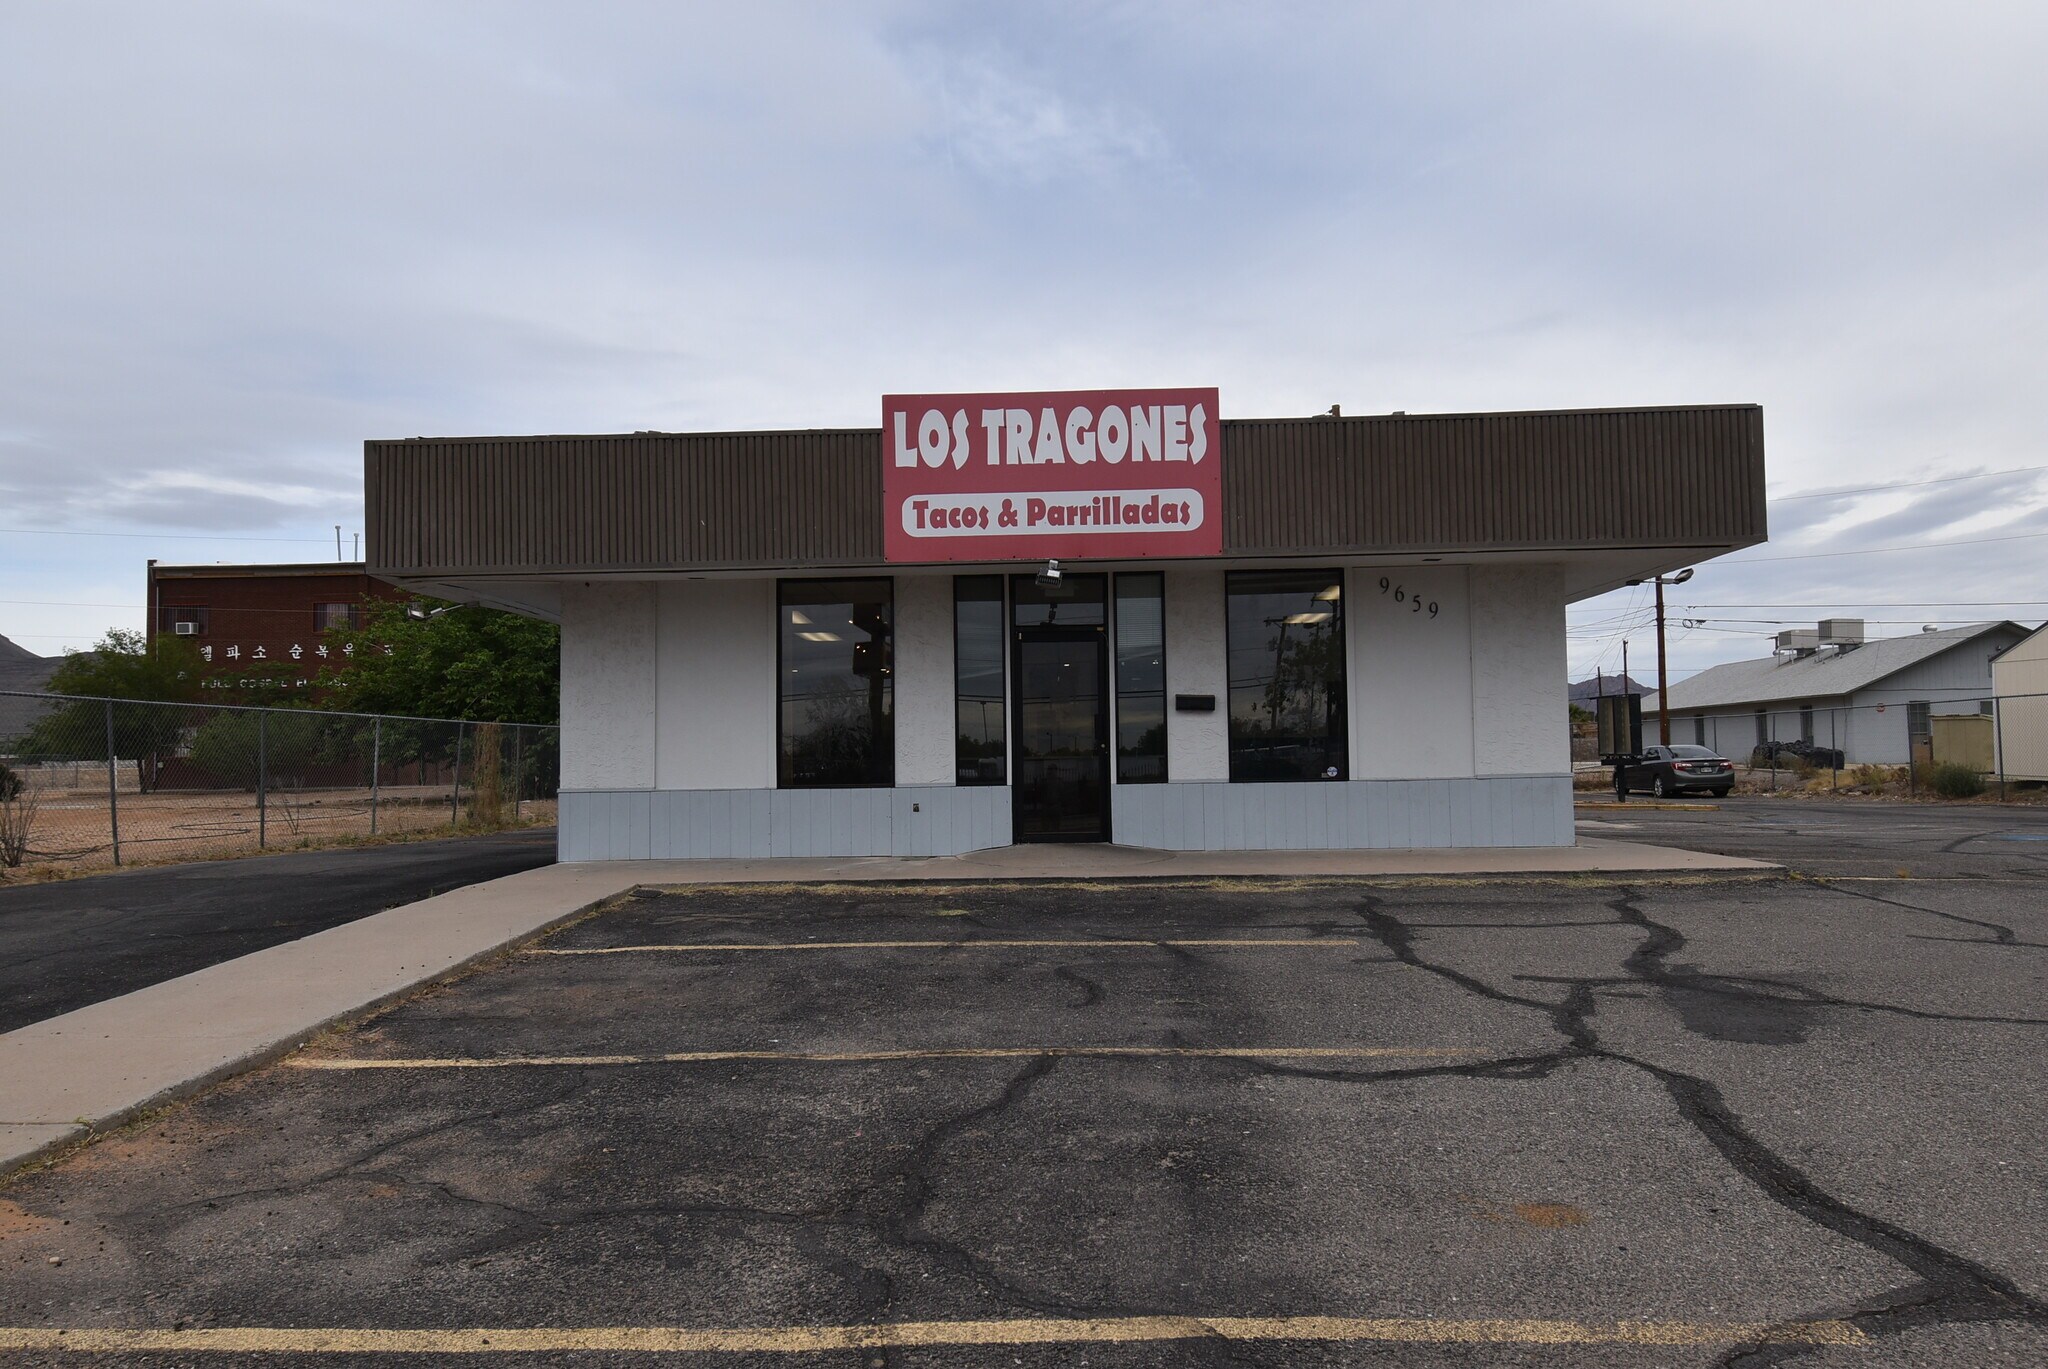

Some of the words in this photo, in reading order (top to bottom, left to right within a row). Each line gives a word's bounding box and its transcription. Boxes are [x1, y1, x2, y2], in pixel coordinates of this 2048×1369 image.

[893, 408, 970, 470] LOS
[981, 402, 1208, 466] TRAGONES
[912, 499, 989, 530] Tacos
[997, 498, 1018, 528] &
[1027, 494, 1191, 527] Parrilladas
[1379, 576, 1438, 619] 9659
[200, 645, 267, 662] 엘파소
